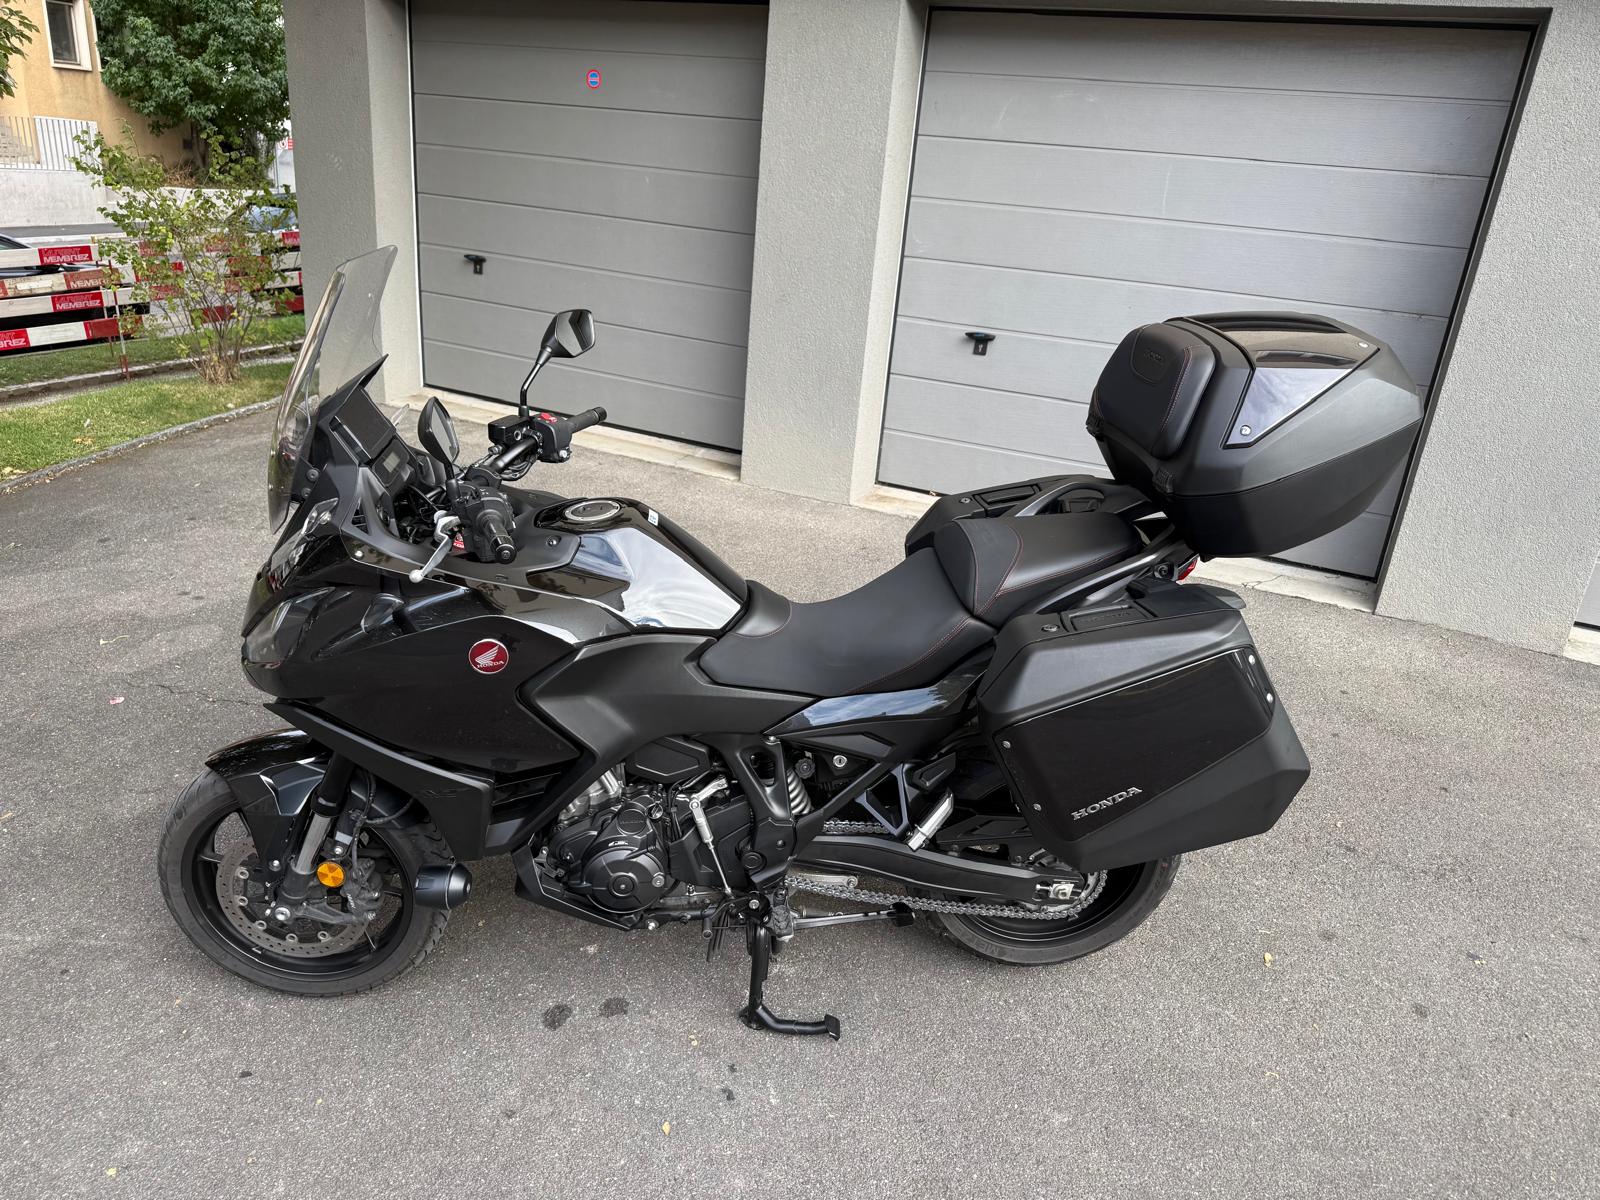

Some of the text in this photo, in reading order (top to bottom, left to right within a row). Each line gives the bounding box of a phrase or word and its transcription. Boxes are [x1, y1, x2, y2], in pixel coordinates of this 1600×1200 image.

[43, 254, 89, 263] MEMBREZ
[56, 300, 101, 310] MEMBREZ
[477, 660, 504, 668] HONDA
[1071, 787, 1142, 820] HONDA
